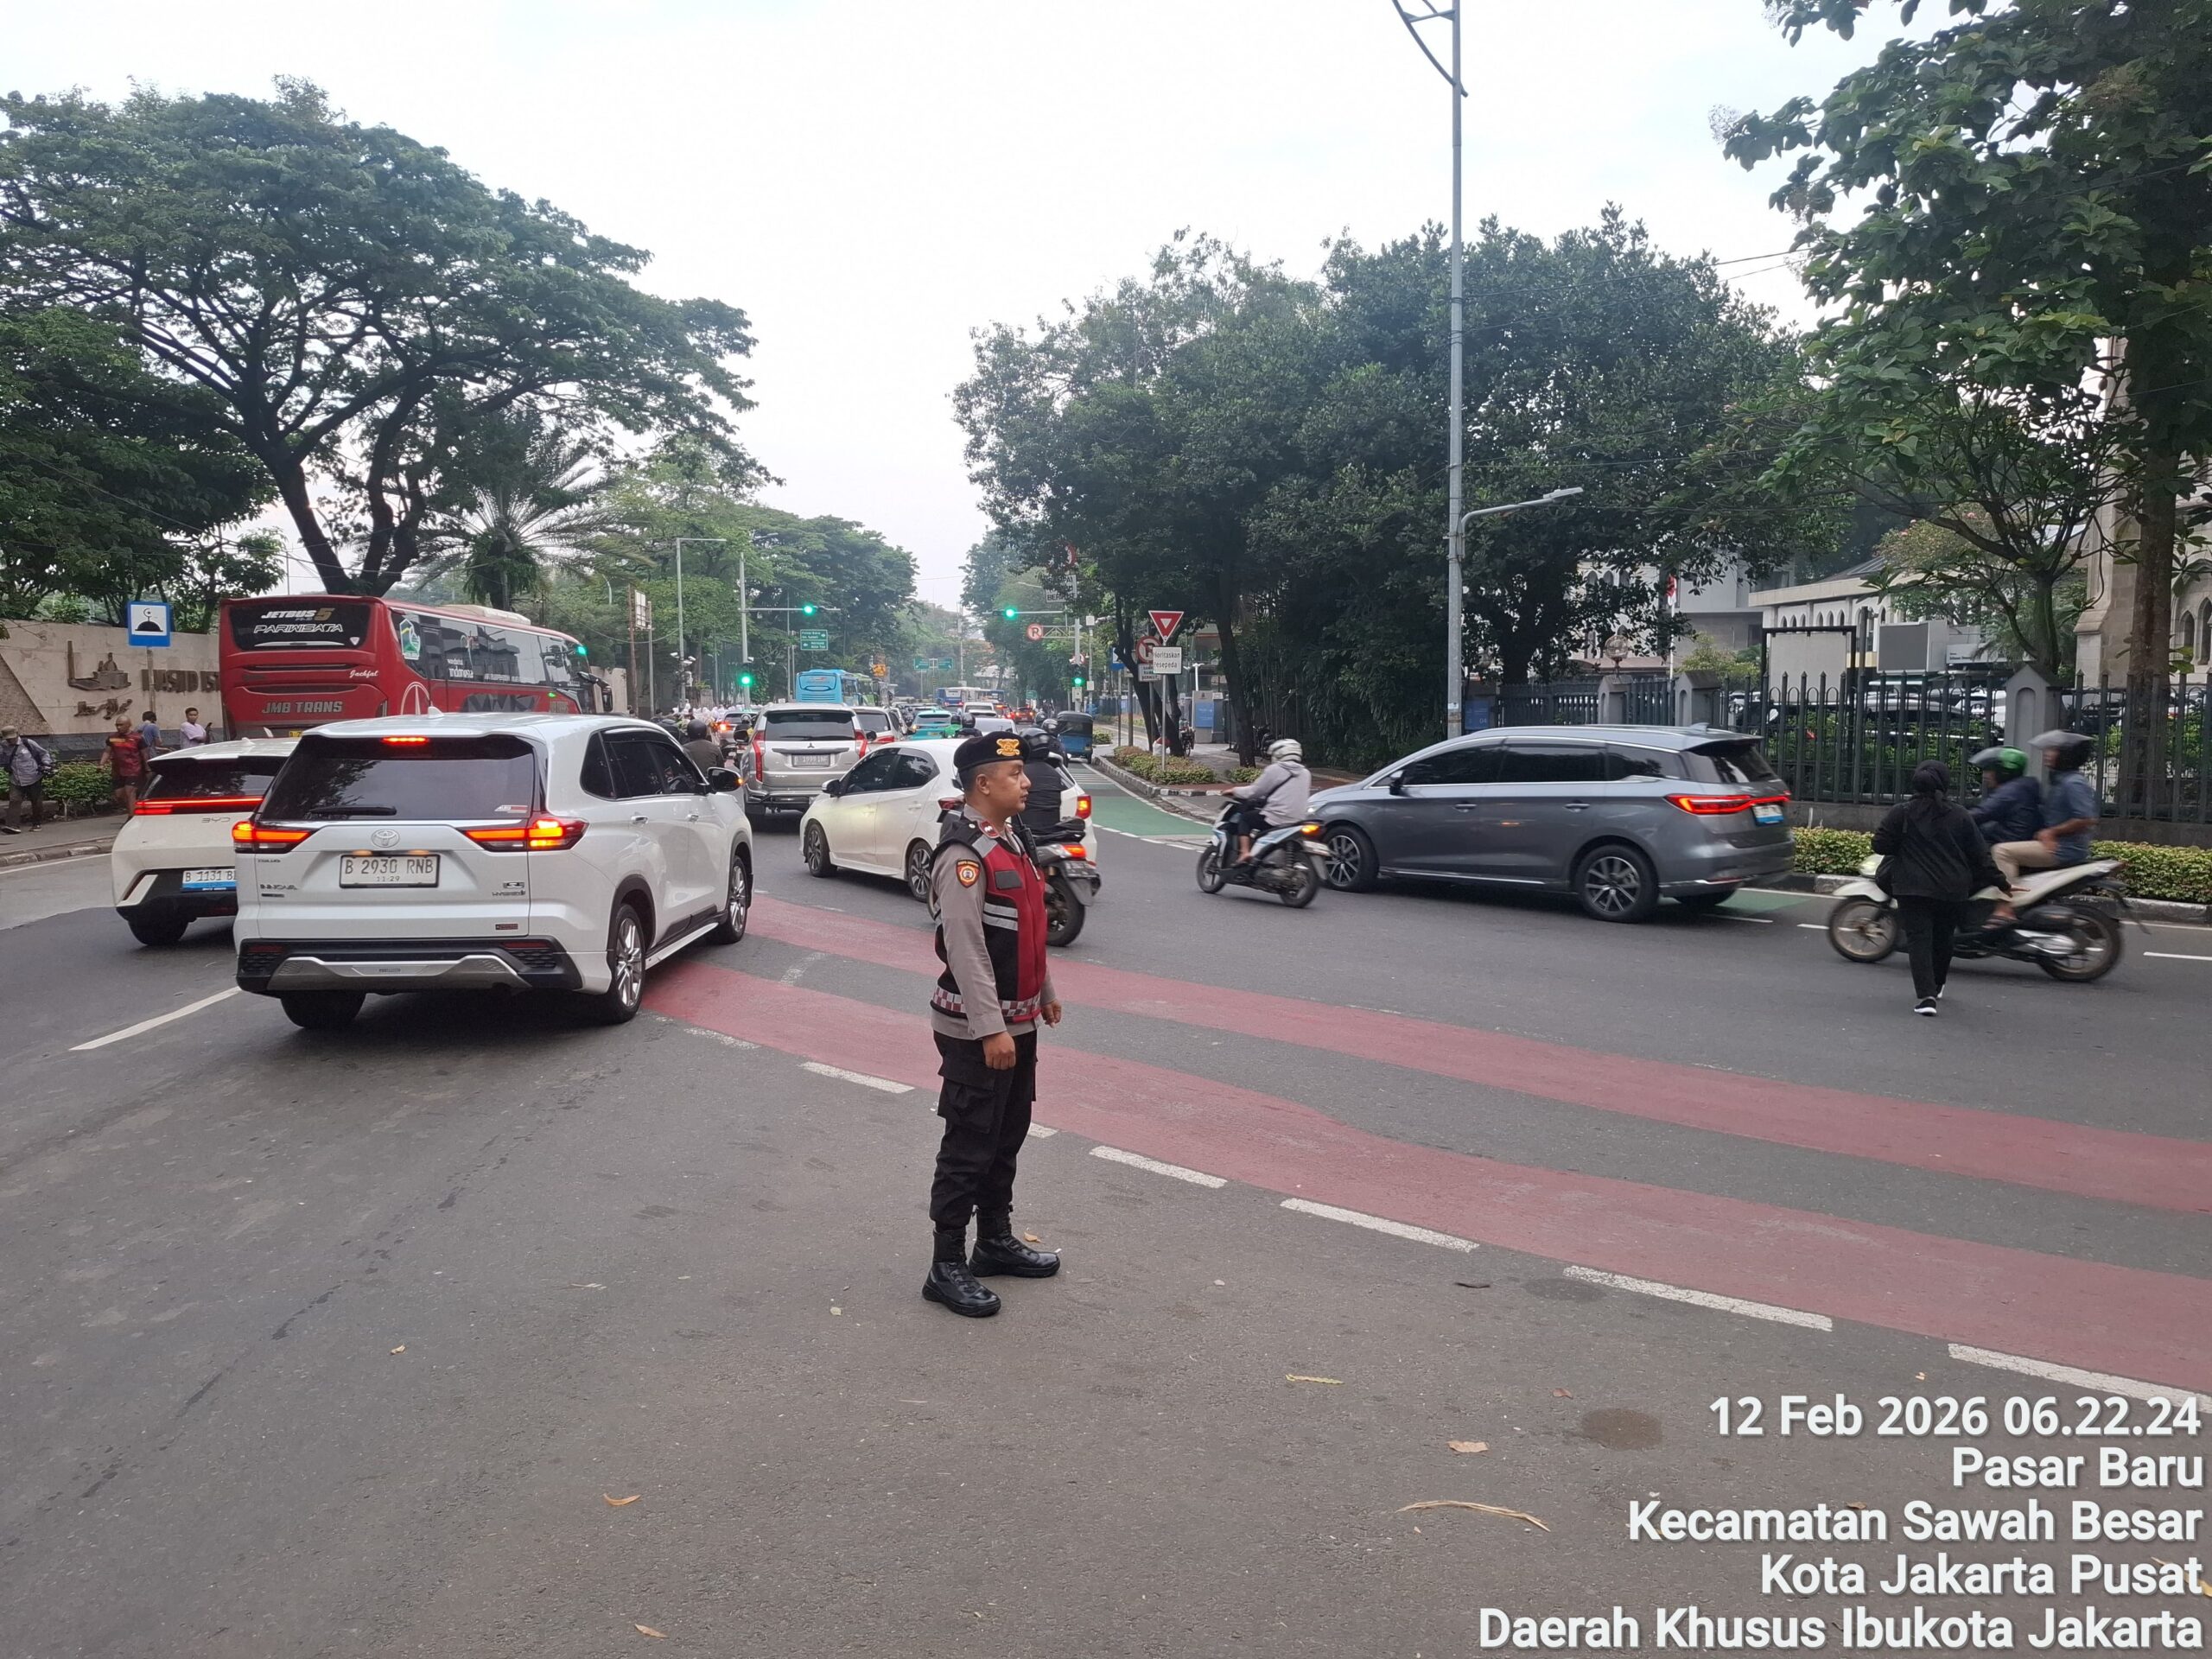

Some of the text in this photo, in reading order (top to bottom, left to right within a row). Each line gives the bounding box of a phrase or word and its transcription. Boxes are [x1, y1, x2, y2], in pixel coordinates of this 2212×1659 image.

[260, 609, 317, 619] JETBUS
[253, 623, 344, 634] PARIWISATA
[261, 701, 343, 714] JMB TRANS
[345, 858, 434, 874] B 2930 RNB
[185, 872, 192, 882] B
[196, 870, 222, 881] 1131
